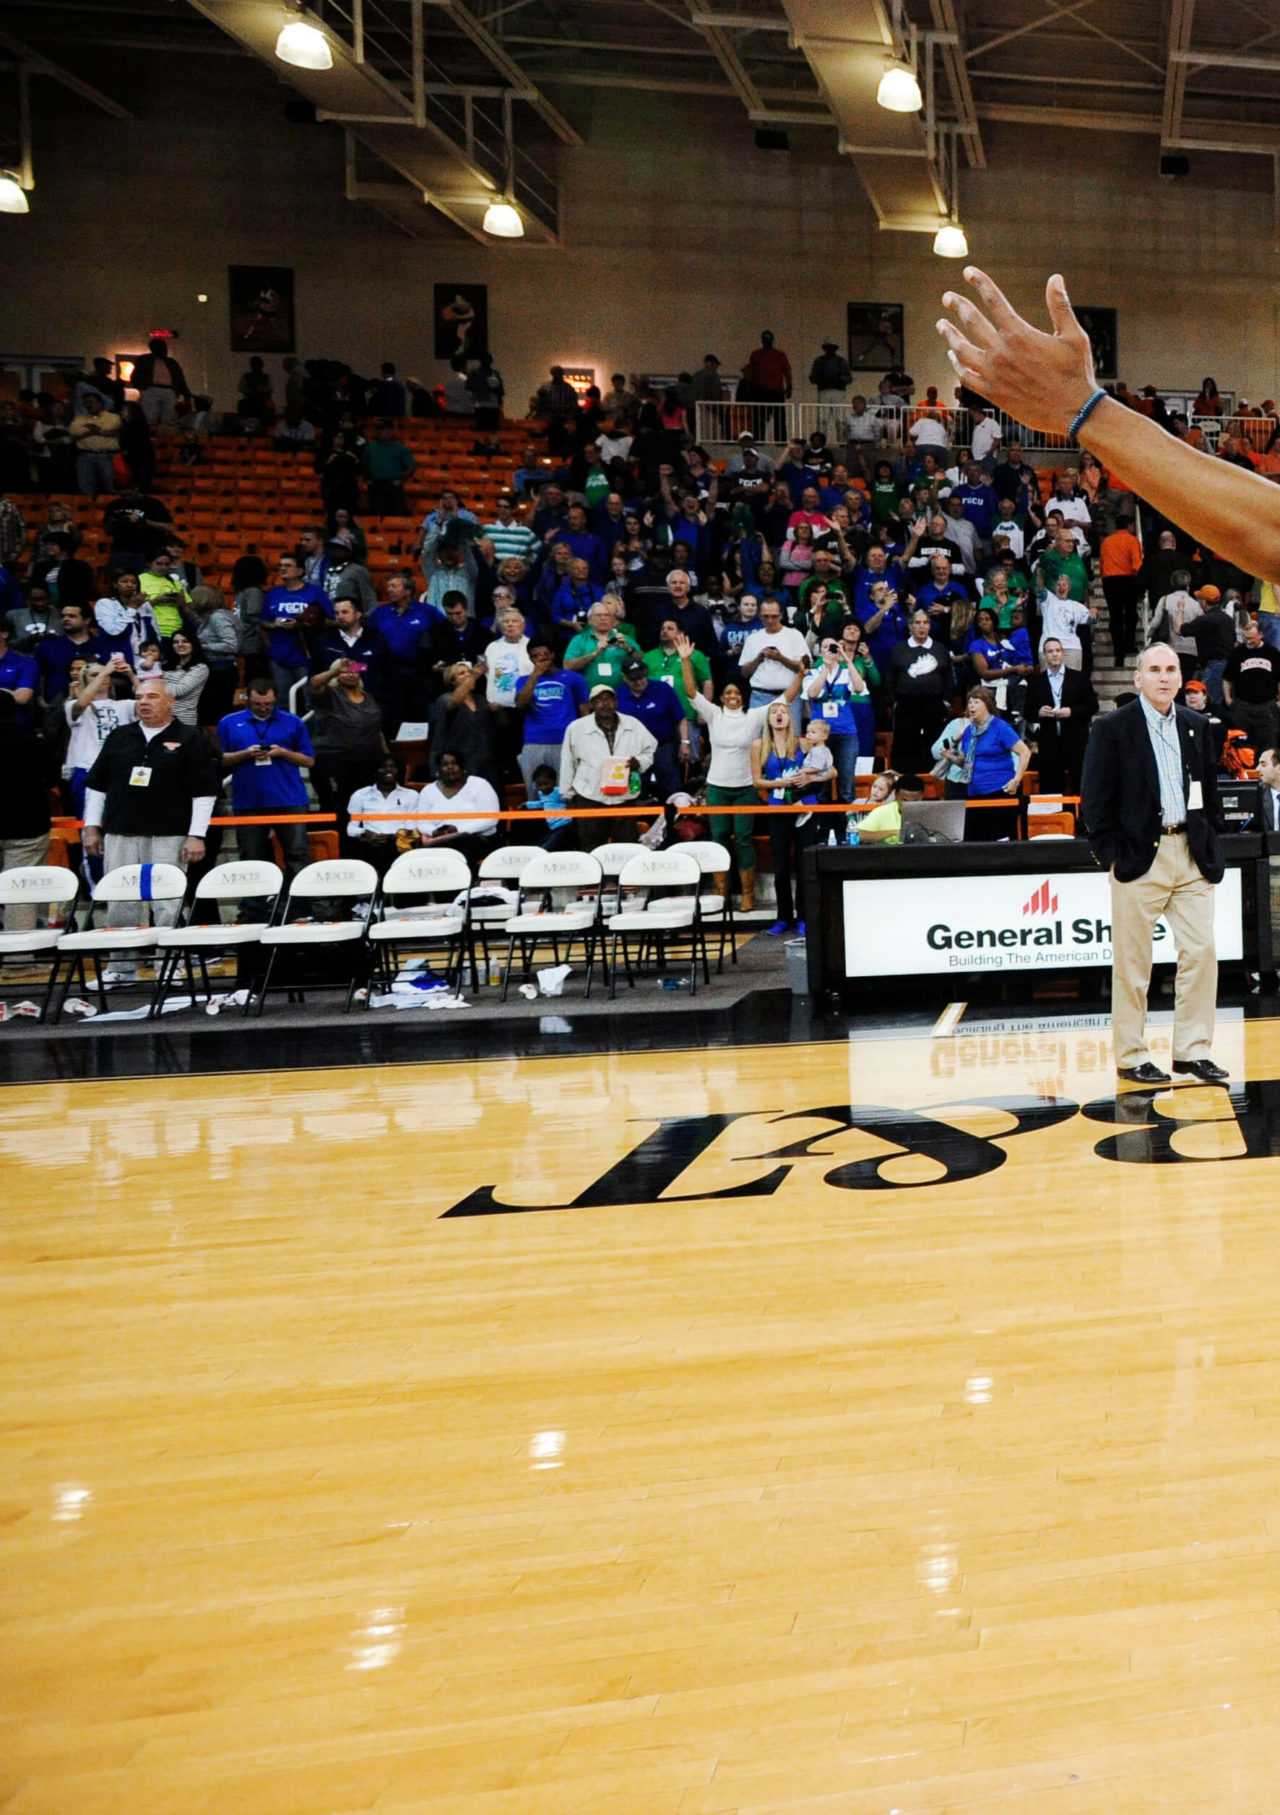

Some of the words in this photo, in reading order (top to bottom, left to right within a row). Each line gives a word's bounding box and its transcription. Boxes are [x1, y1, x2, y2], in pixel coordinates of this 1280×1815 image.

[926, 920, 1063, 950] General
[1071, 918, 1167, 945] She
[948, 952, 1003, 968] Building
[1007, 951, 1032, 965] The
[1035, 949, 1100, 964] American
